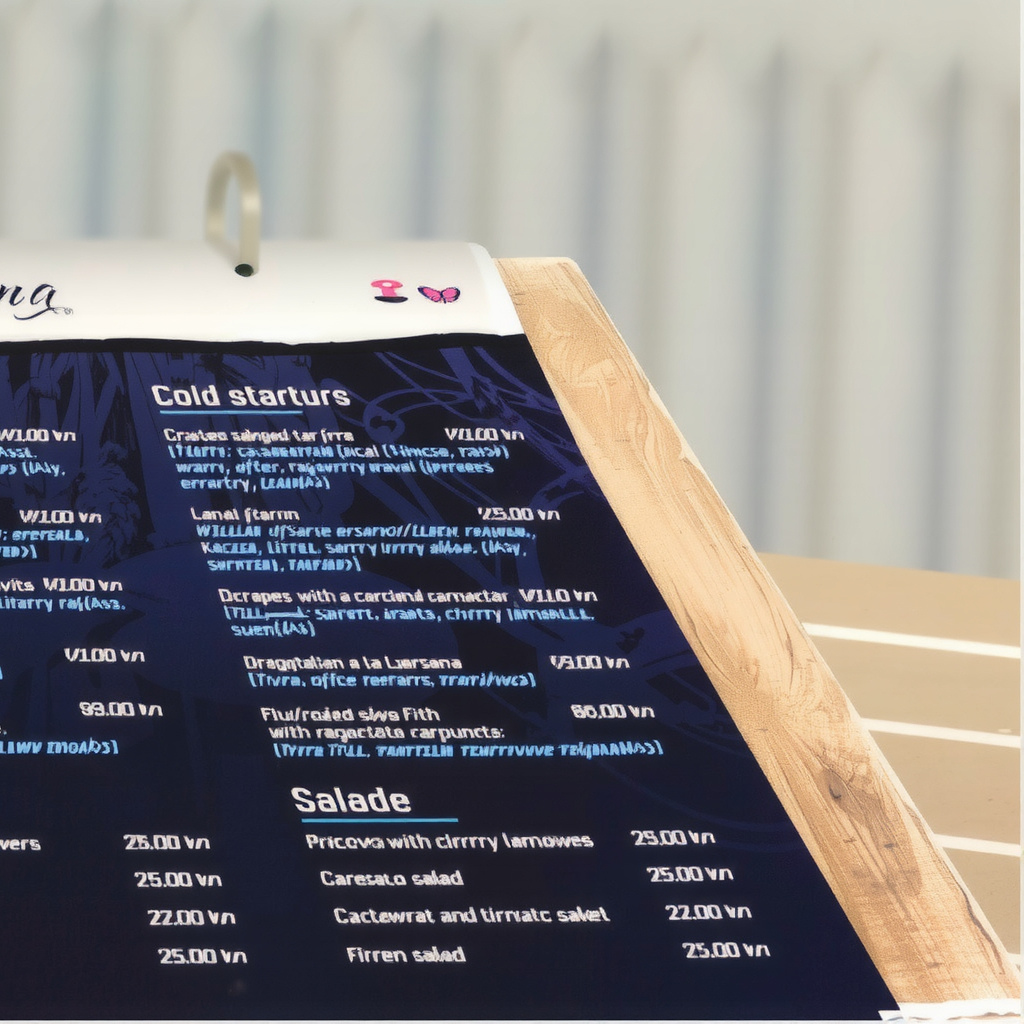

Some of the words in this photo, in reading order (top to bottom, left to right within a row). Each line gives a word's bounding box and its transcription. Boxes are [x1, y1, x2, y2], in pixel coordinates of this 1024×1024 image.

[150, 384, 221, 407] Cold
[290, 786, 412, 813] Salade
[133, 871, 194, 888] 25.00
[646, 865, 707, 883] 25.00
[147, 909, 205, 926] 22.00
[664, 904, 726, 921] 22.00
[157, 948, 218, 965] 25.00
[681, 941, 741, 959] 25.00
